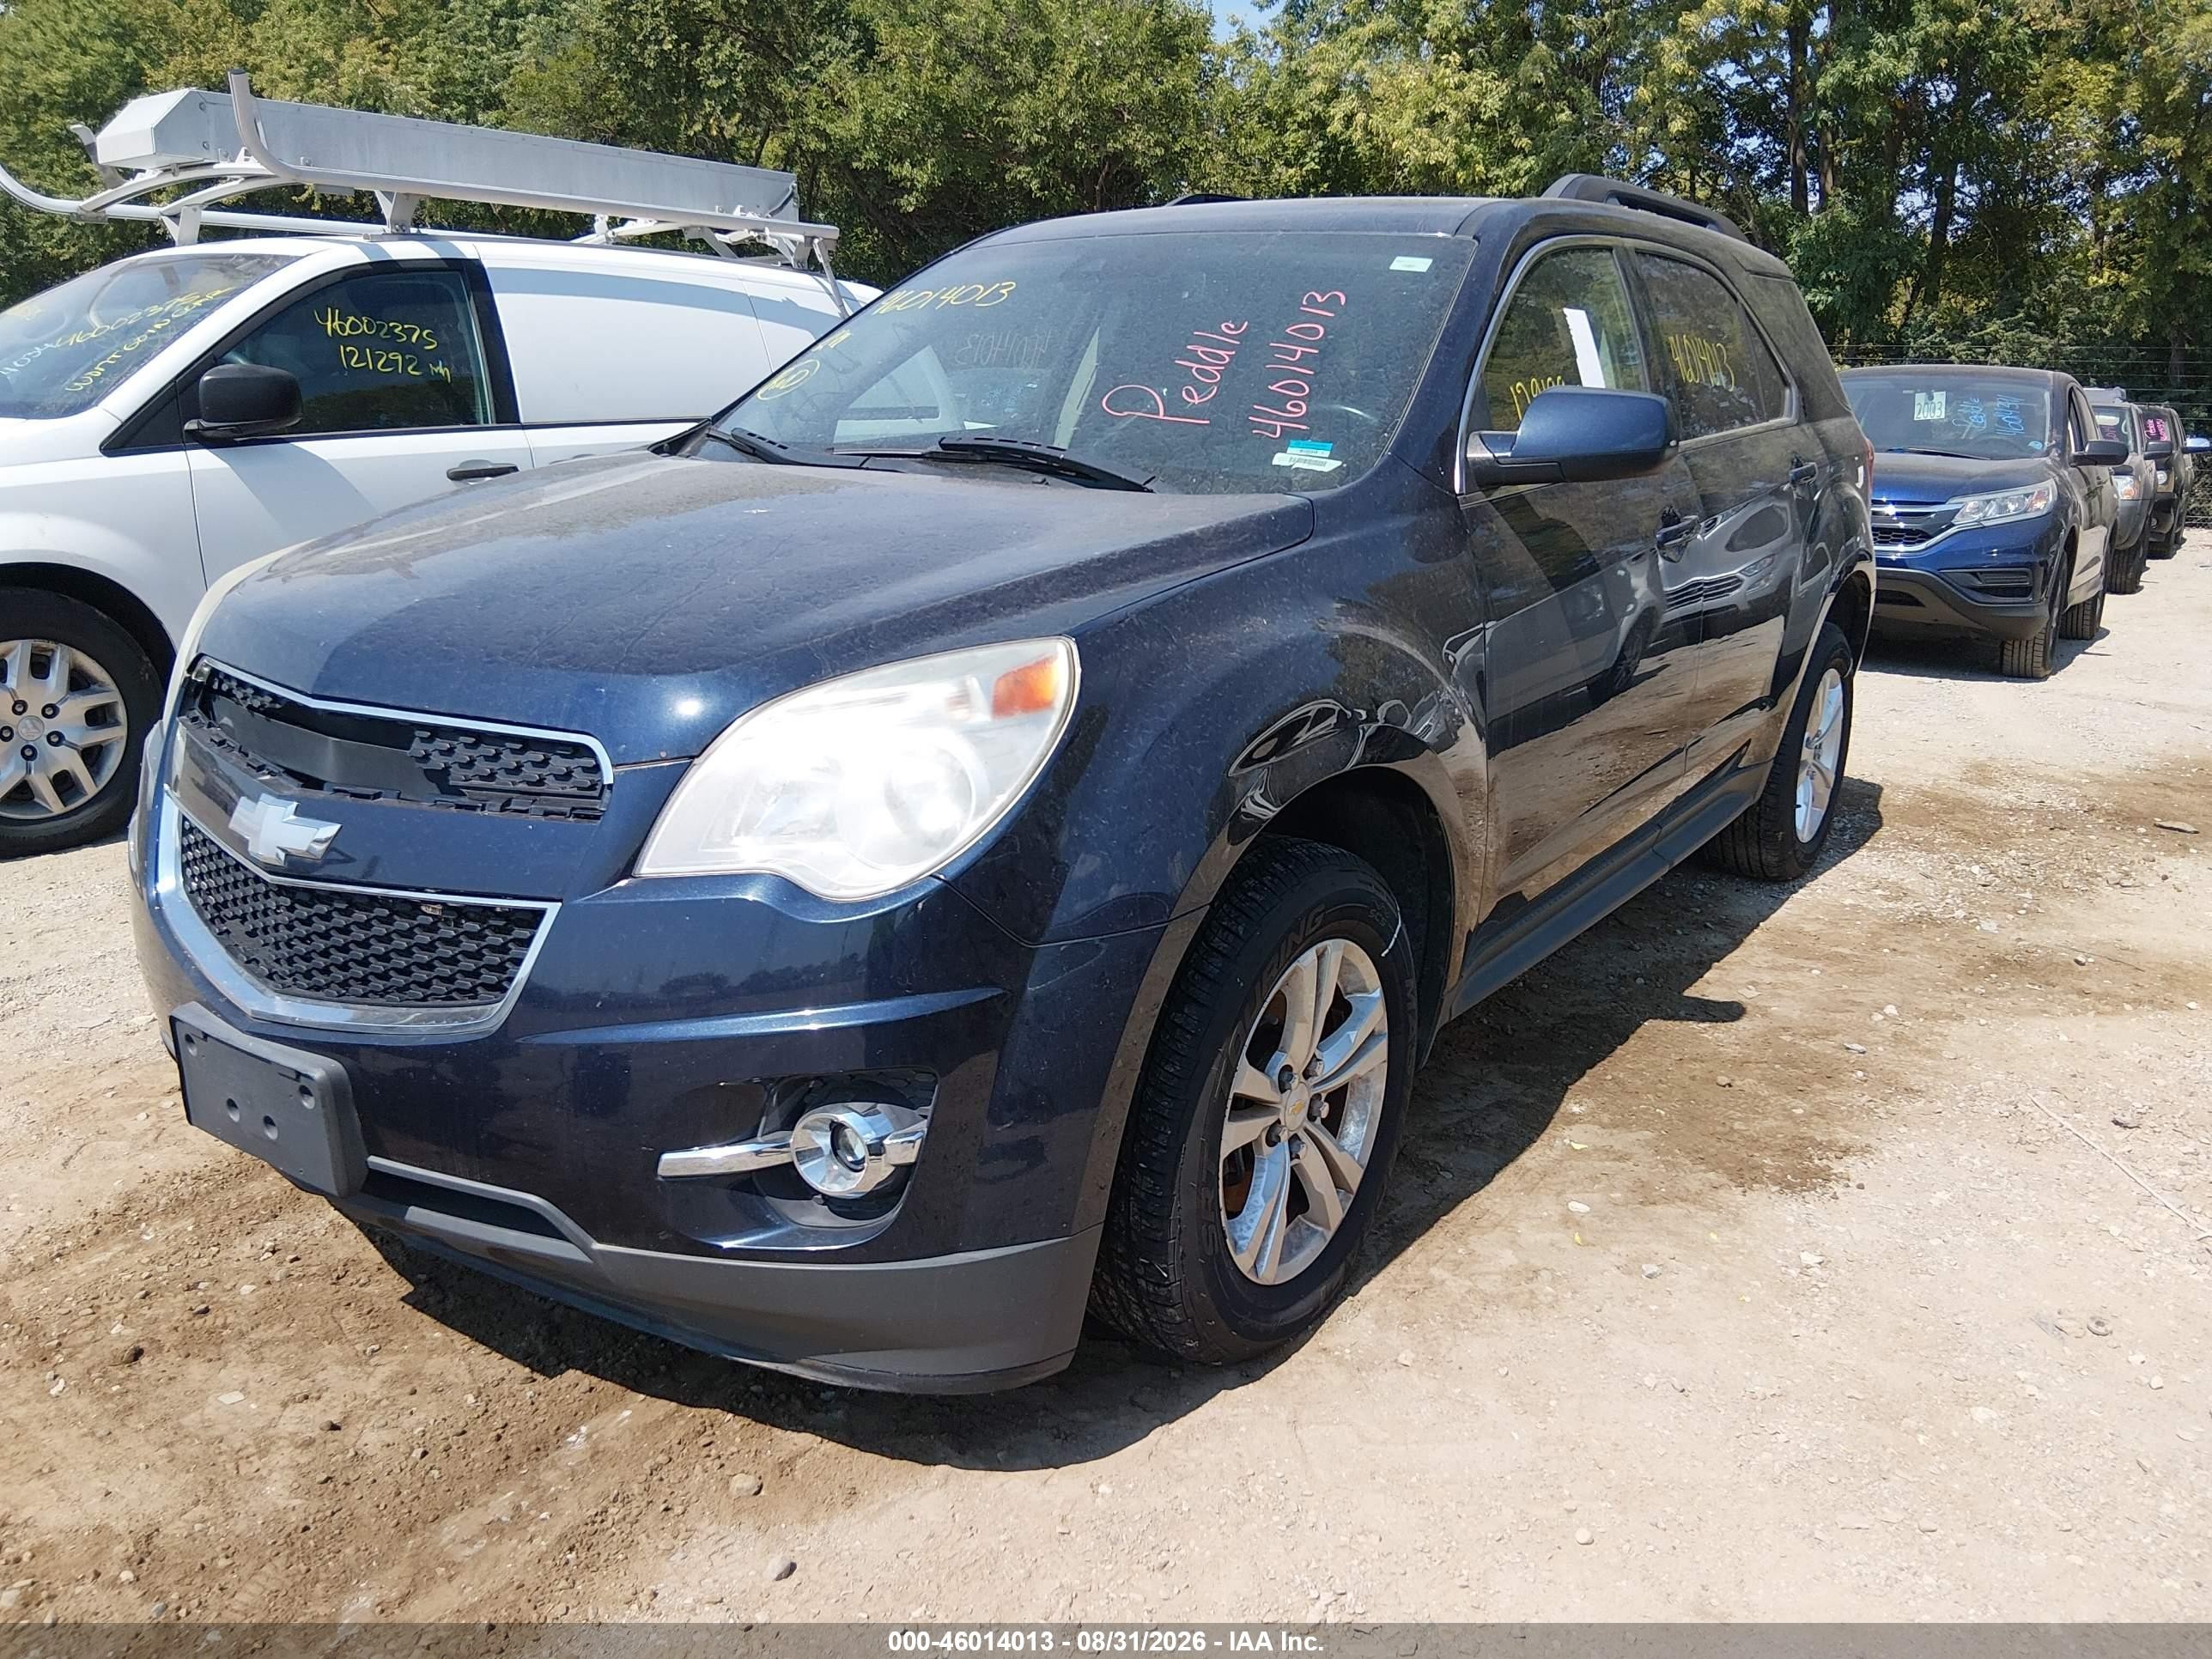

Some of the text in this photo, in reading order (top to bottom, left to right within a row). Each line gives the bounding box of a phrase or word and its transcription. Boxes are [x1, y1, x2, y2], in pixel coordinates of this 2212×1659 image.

[872, 282, 1017, 315] 46014013
[314, 307, 438, 350] 46002375
[340, 344, 423, 376] 121292
[1102, 320, 1249, 424] Peddle
[1248, 291, 1346, 438] 46014013
[1915, 401, 1943, 419] 2003
